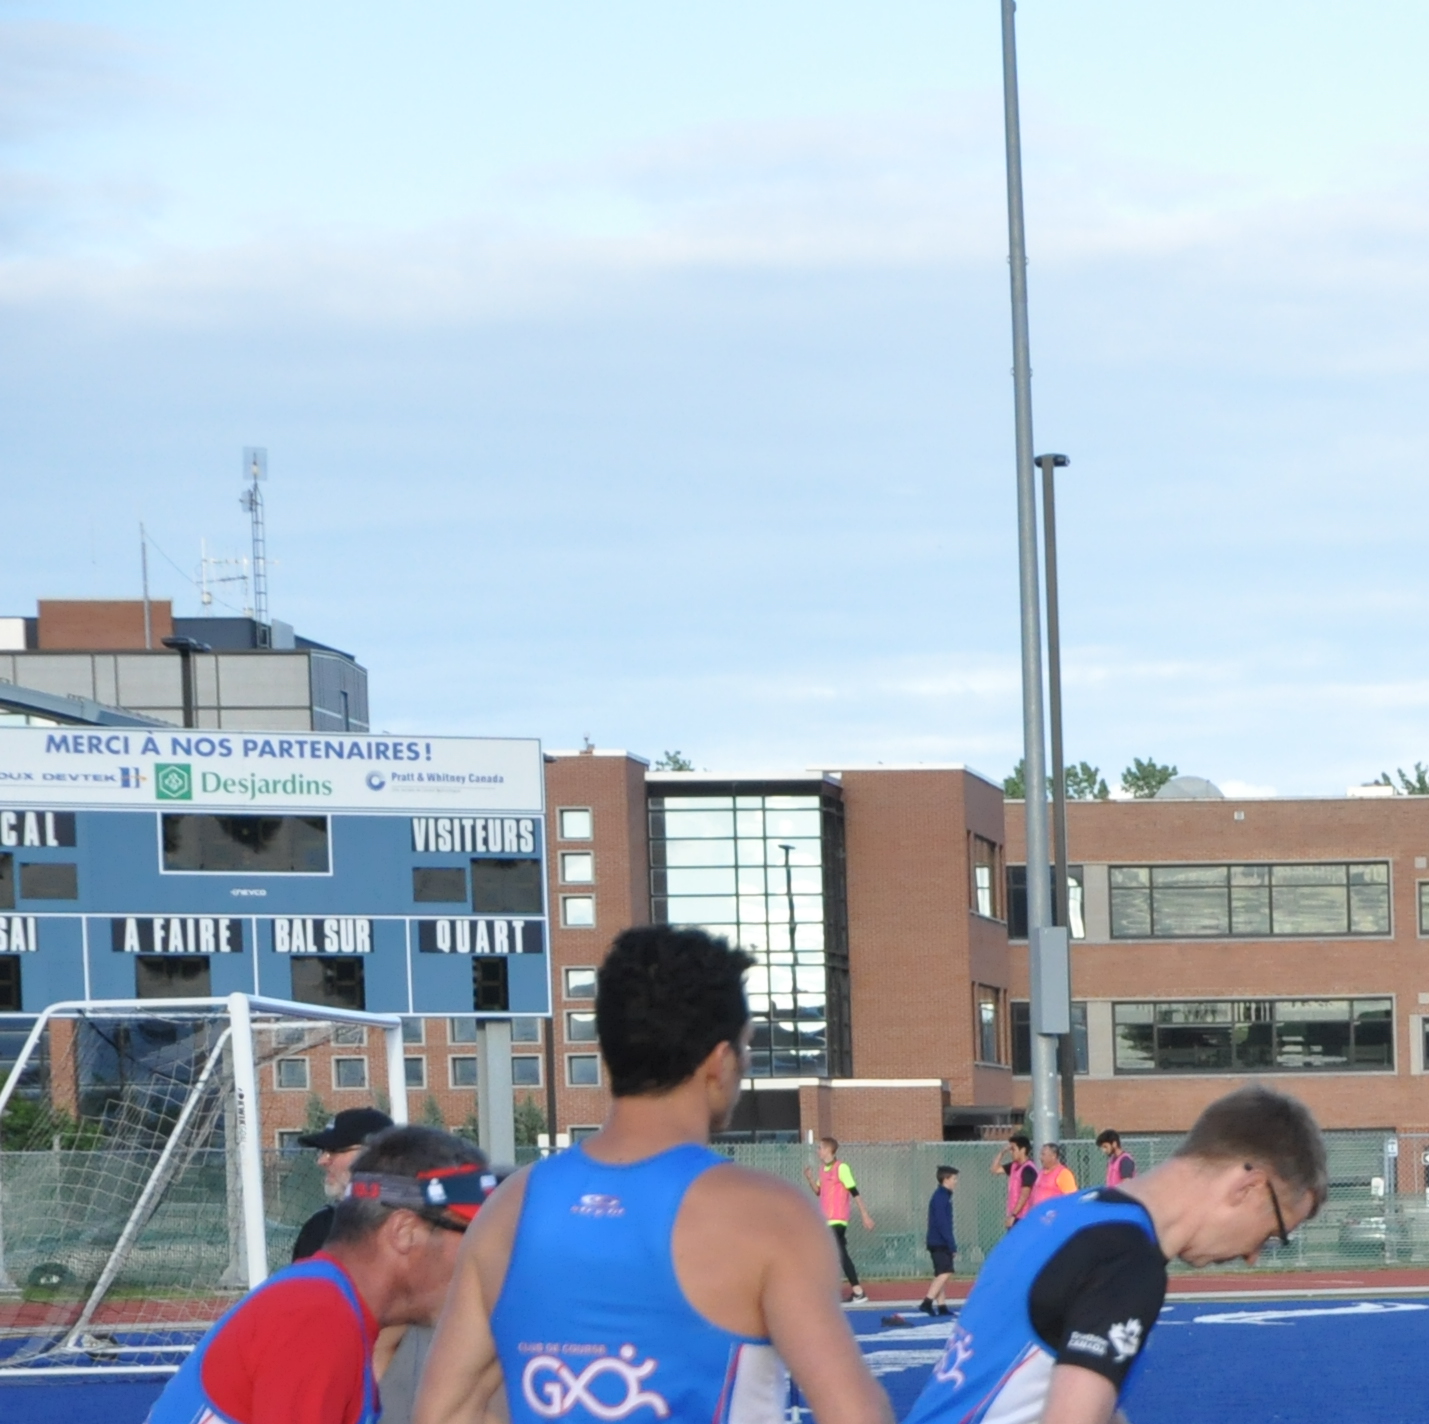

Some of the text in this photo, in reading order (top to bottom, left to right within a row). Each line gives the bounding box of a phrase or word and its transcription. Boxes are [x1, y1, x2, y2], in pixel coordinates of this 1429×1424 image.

[45, 734, 130, 755] MERCI
[140, 730, 161, 755] À
[171, 736, 233, 757] NOS
[42, 772, 117, 782] DEVTEK
[201, 771, 333, 800] Desjardins
[391, 772, 505, 784] Pratt & Whitney Canada
[412, 817, 534, 853] VISITEURS
[123, 918, 232, 952] A FAIRE
[274, 918, 371, 954] BAL SUR
[435, 919, 525, 954] QUART
